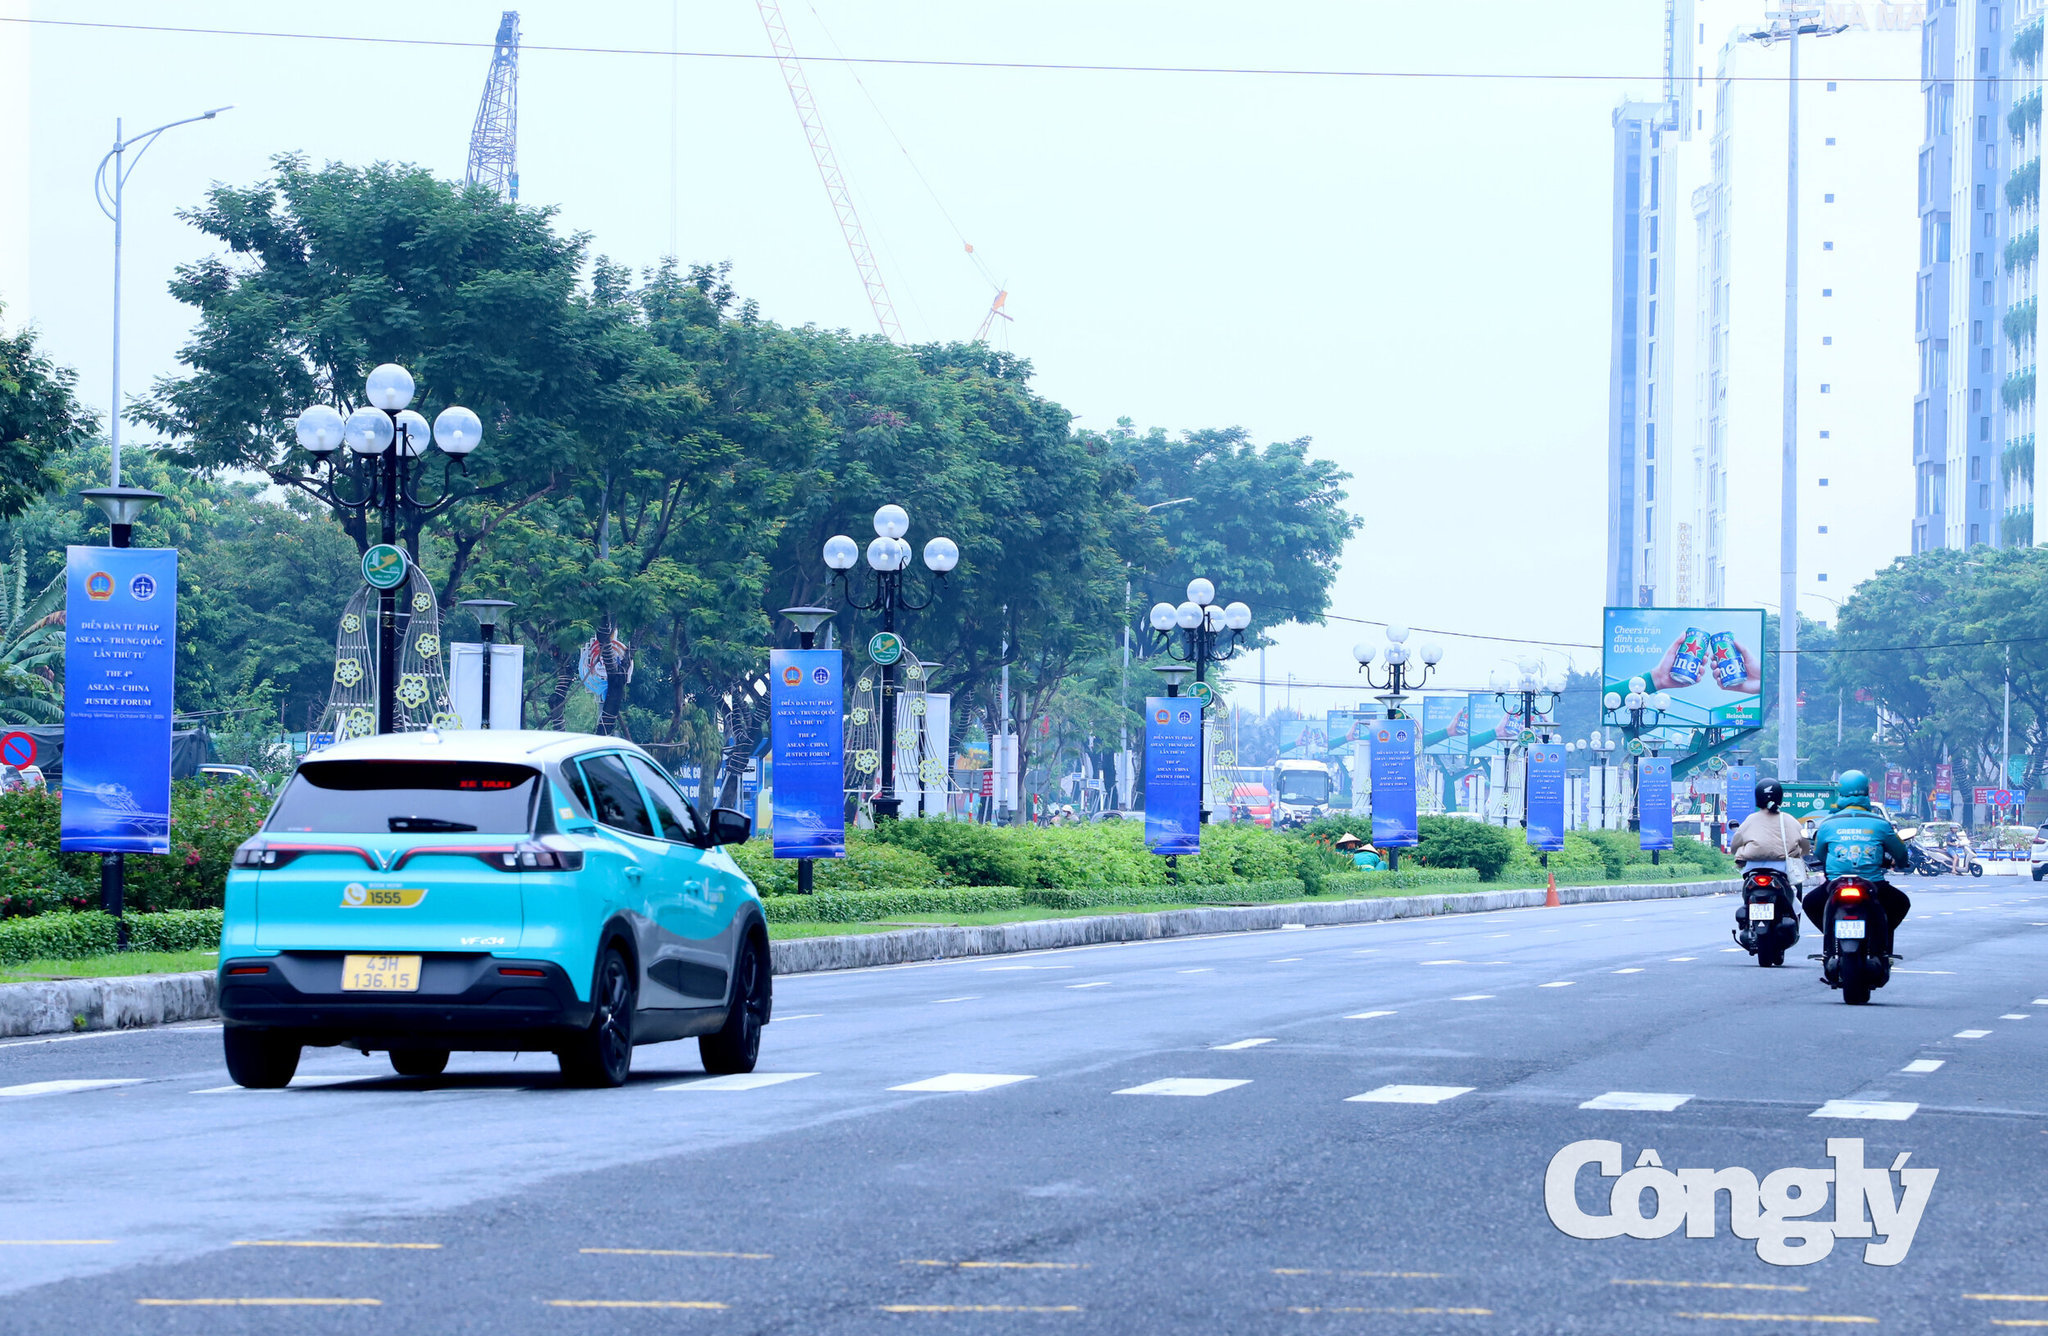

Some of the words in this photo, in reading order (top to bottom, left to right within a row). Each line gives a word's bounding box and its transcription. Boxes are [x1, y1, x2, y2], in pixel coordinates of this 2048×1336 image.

[137, 622, 160, 631] PHÁP
[1614, 625, 1642, 635] Cheers
[110, 637, 139, 645] TRUNG
[140, 635, 165, 646] QUỐC
[87, 683, 115, 691] ASEAN
[122, 684, 150, 692] CHINA
[84, 697, 119, 705] JUSTICE
[120, 698, 151, 706] FORUM
[460, 780, 477, 788] XE
[482, 780, 511, 788] TAXI
[370, 892, 402, 904] 1555
[366, 956, 399, 971] 43H
[354, 973, 410, 988] 136.15
